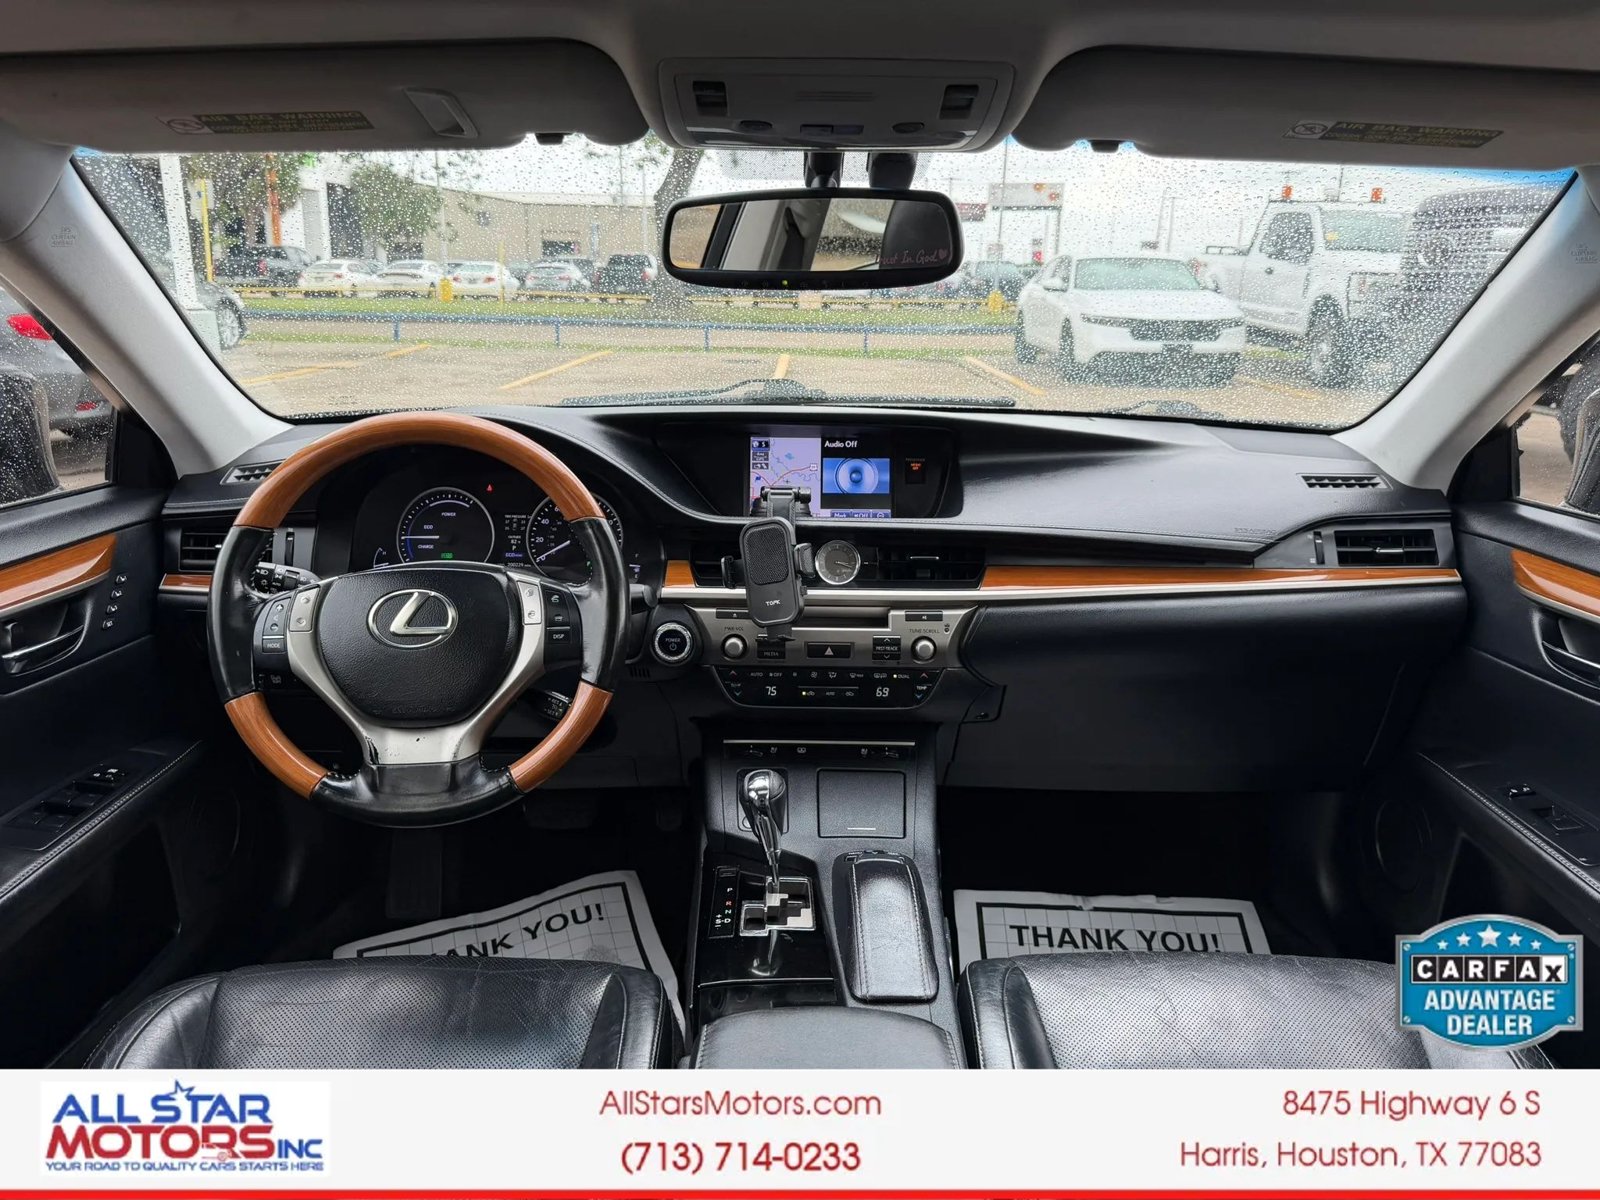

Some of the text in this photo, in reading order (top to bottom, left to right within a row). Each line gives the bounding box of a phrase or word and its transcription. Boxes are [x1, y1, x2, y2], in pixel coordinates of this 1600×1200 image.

[236, 113, 272, 121] BAG
[280, 110, 362, 119] WARNING
[1337, 122, 1500, 138] AIR BAG WARNING
[901, 250, 914, 264] In
[916, 249, 938, 264] God
[824, 440, 858, 448] Audio Off
[765, 685, 777, 696] 75
[523, 903, 604, 940] YOU!
[1009, 925, 1221, 952] THANK YOU!
